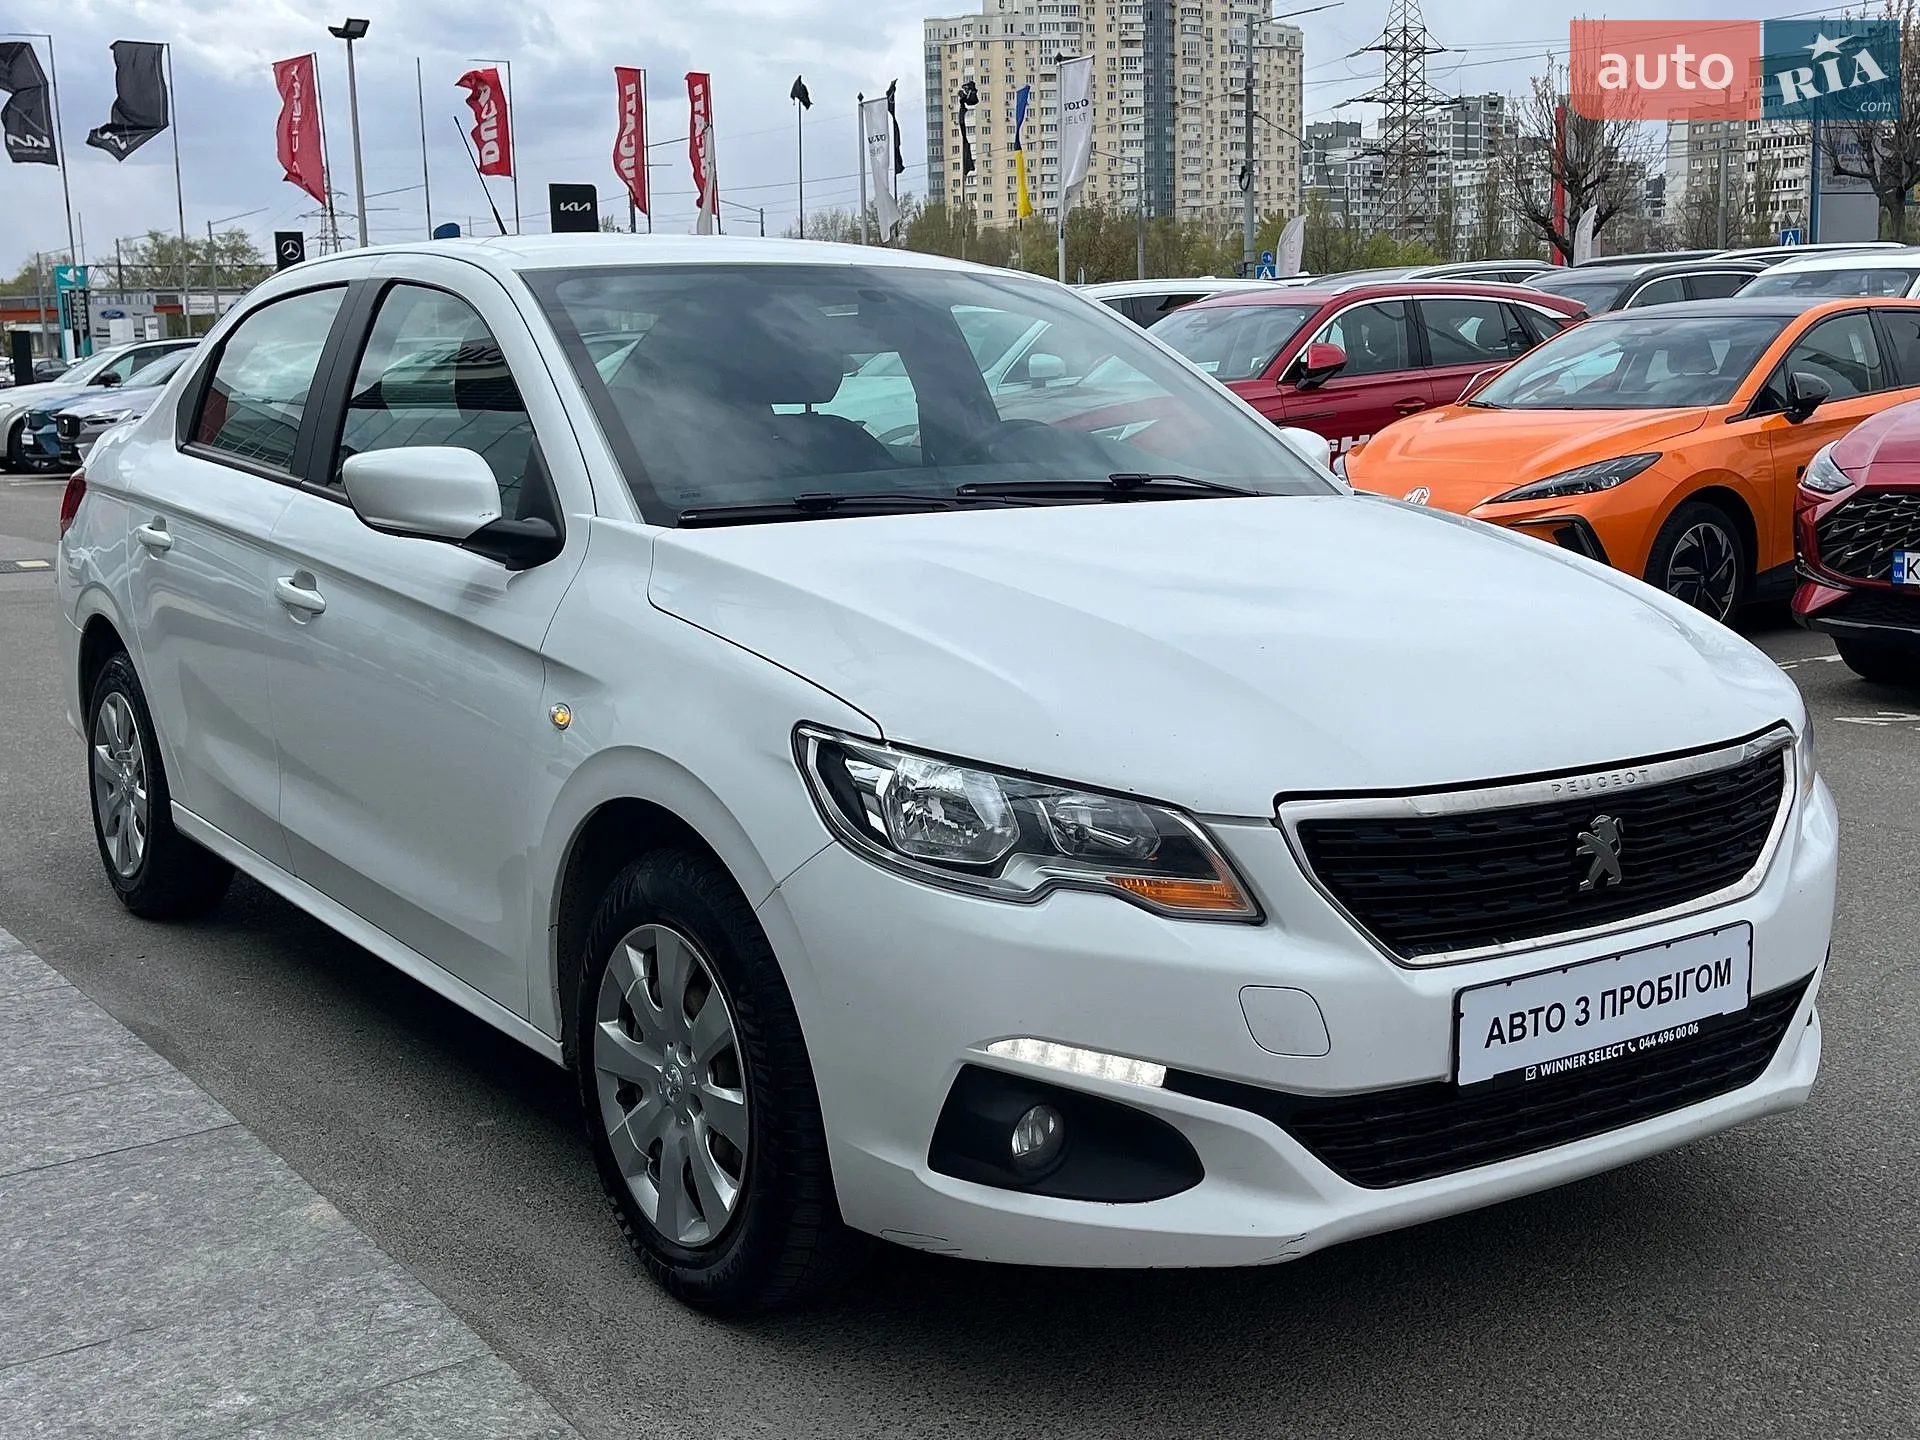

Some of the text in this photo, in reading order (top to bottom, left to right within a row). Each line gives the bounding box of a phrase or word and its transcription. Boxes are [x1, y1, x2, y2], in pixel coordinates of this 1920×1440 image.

[560, 202, 591, 211] KIA
[1893, 570, 1904, 578] UA
[1551, 769, 1648, 798] PEUGEOT
[1484, 1002, 1566, 1049] АВТО
[1600, 957, 1732, 1020] ПРОБІГОМ
[1540, 1022, 1699, 1076] WINNER SELECT 044 496 00 06
